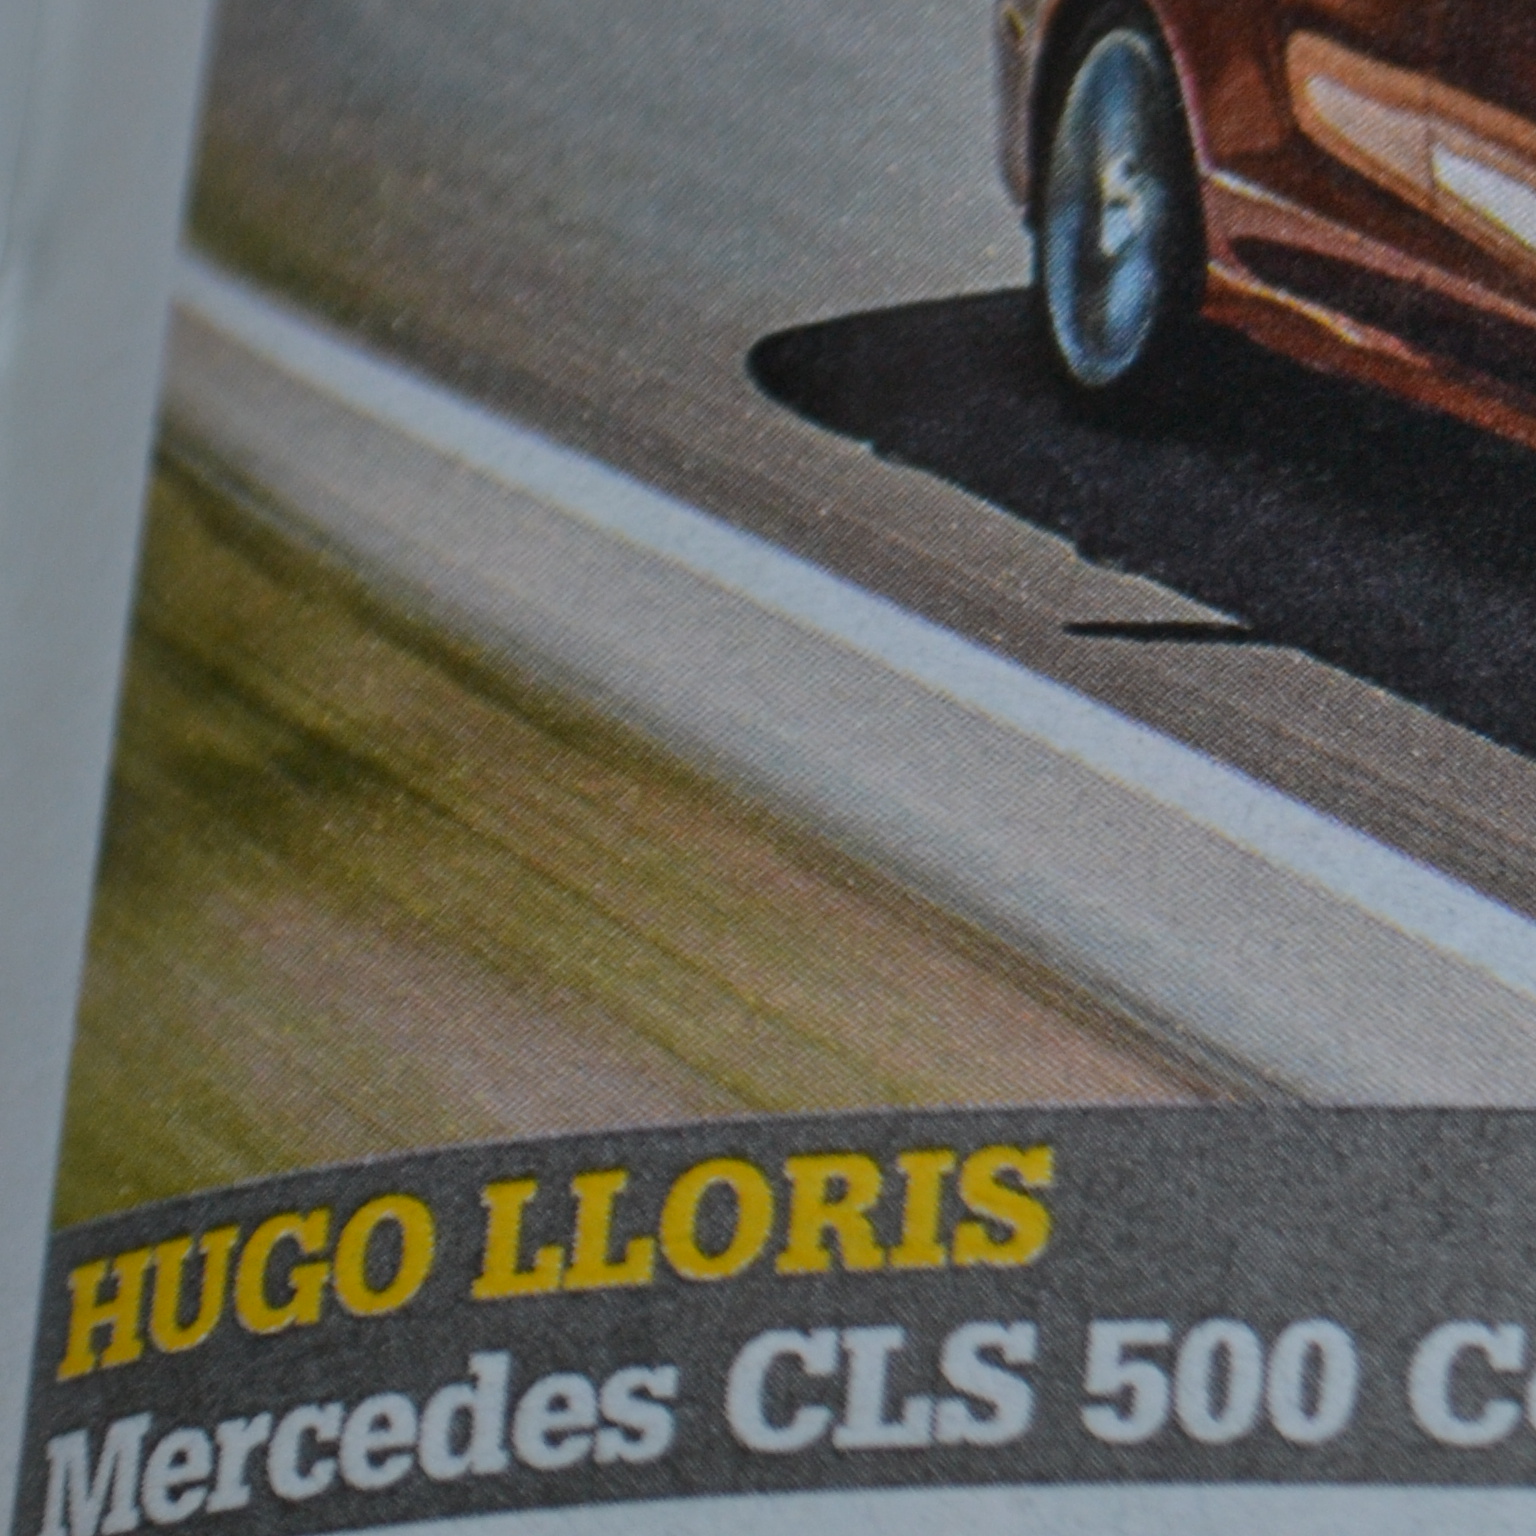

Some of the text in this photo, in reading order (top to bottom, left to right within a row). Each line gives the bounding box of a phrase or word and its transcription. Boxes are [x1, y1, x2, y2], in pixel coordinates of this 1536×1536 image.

[55, 1145, 1055, 1382] HUGO LLORIS
[38, 1352, 680, 1536] Mercedes
[724, 1319, 1037, 1455] CLS
[1081, 1319, 1360, 1449] 500
